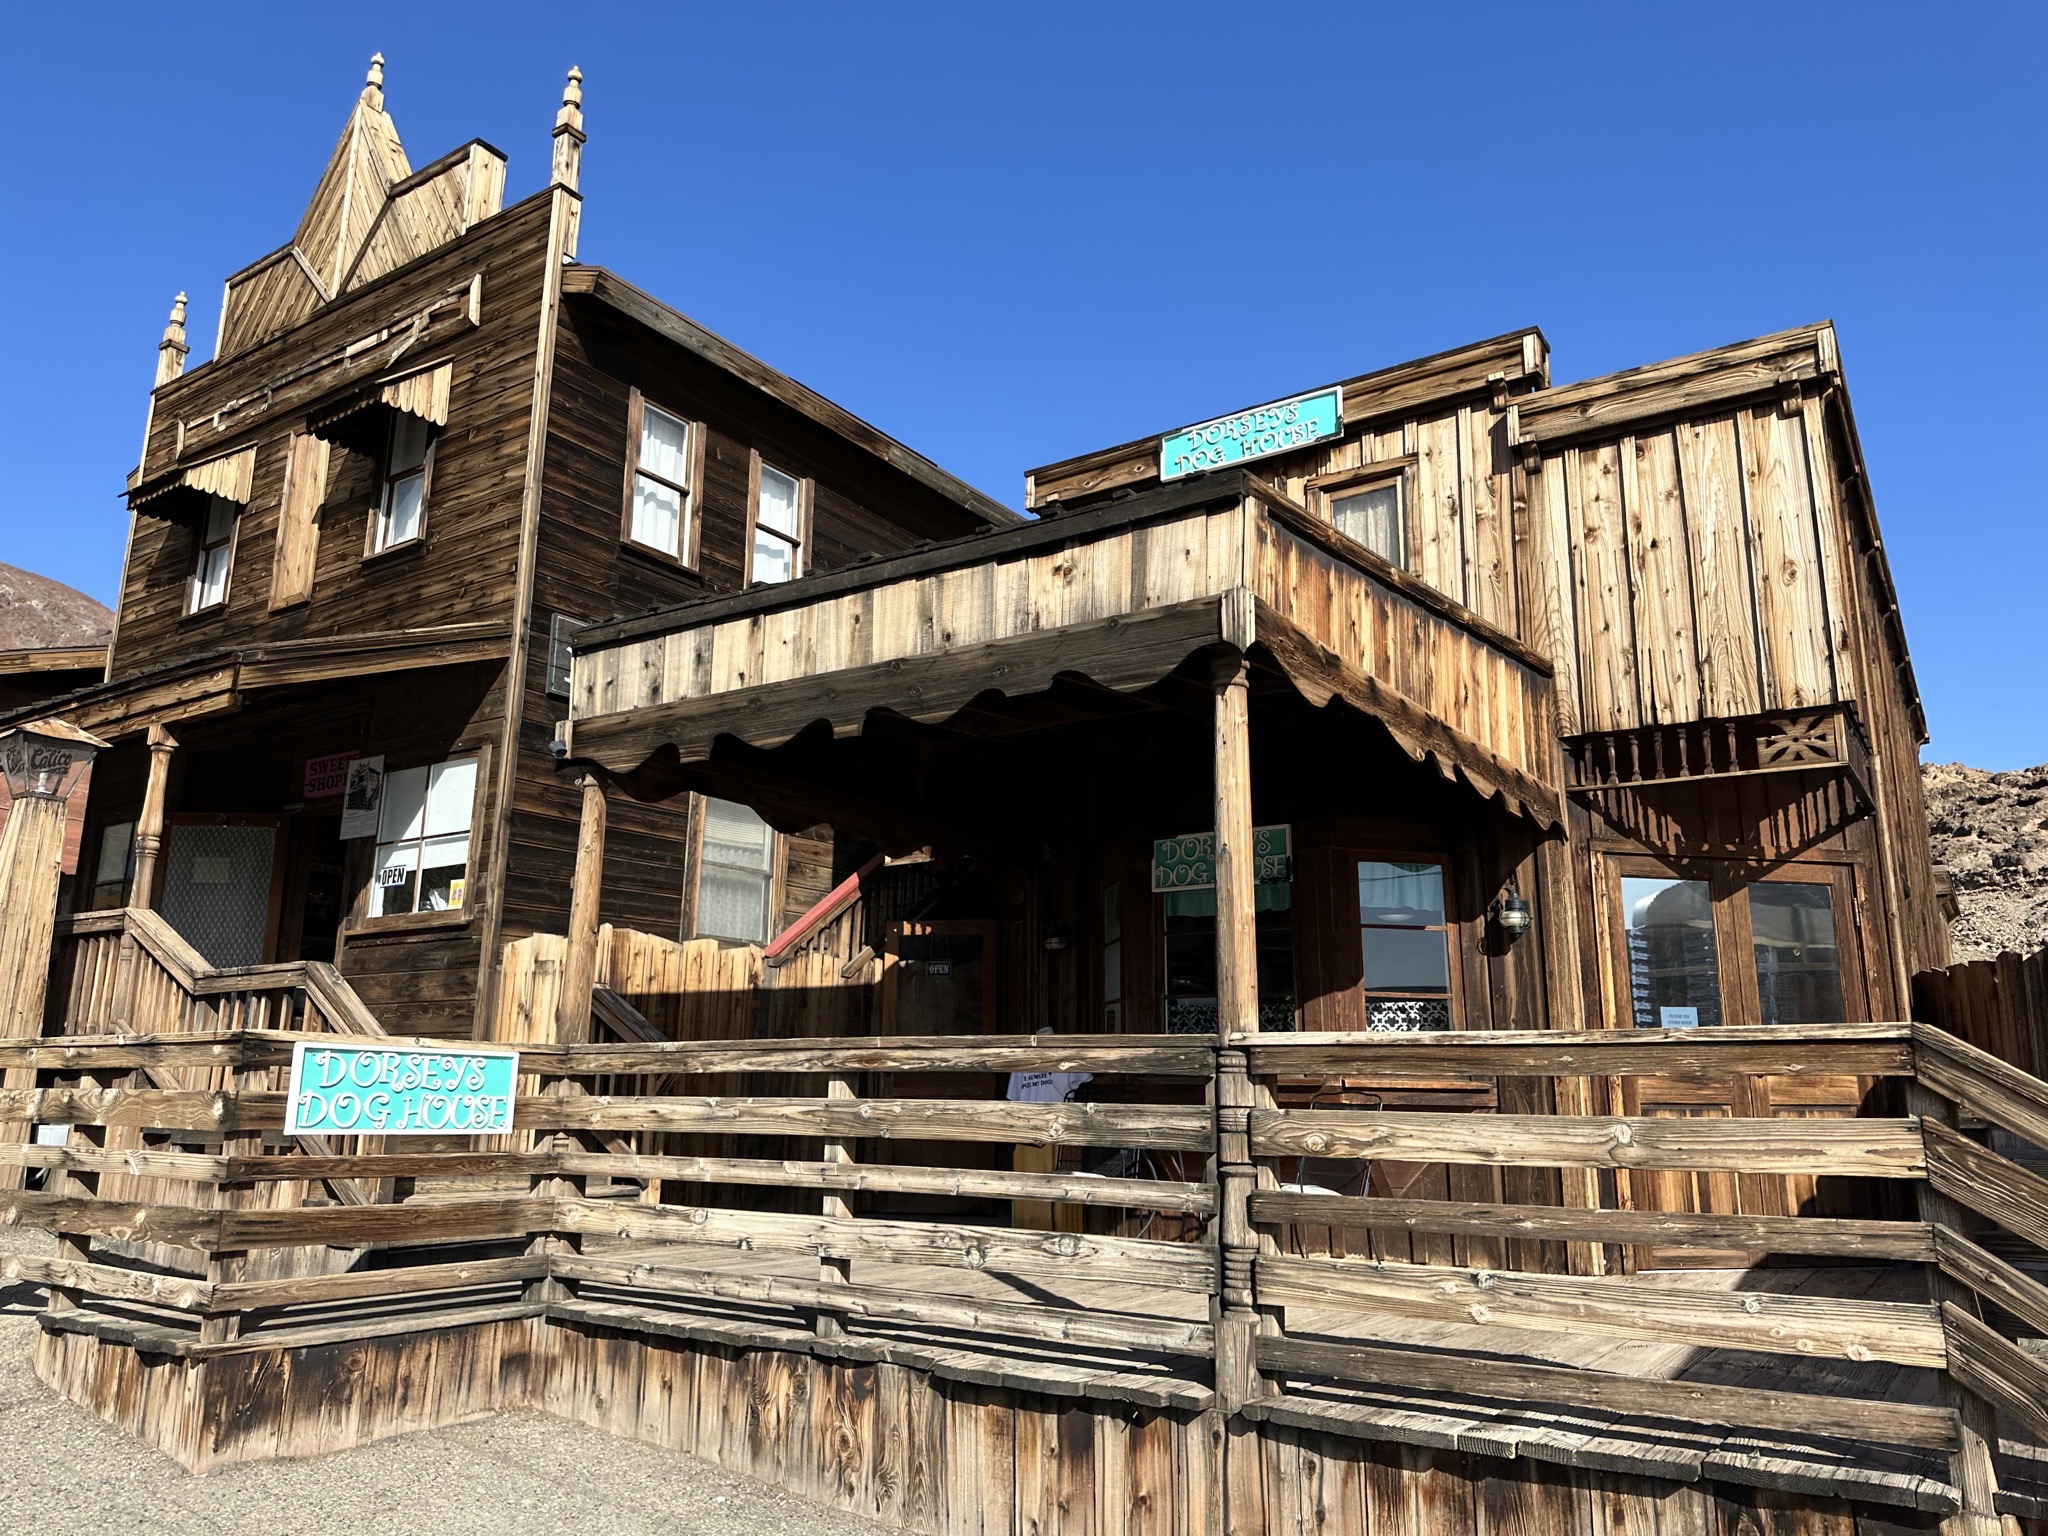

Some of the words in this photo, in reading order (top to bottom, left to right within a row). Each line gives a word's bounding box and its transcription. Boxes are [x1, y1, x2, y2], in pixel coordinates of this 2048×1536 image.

[1187, 402, 1300, 450] DORSEYS
[1174, 444, 1227, 473] DOG
[1241, 418, 1320, 458] HOUSE
[30, 747, 73, 770] Calico
[1161, 830, 1272, 864] DORS
[381, 867, 405, 886] OPEN
[1155, 862, 1209, 887] DOG
[929, 964, 949, 974] OPEN
[315, 1050, 487, 1093] DORSEYS
[298, 1089, 391, 1129] DOG
[396, 1093, 508, 1130] HOUSE
